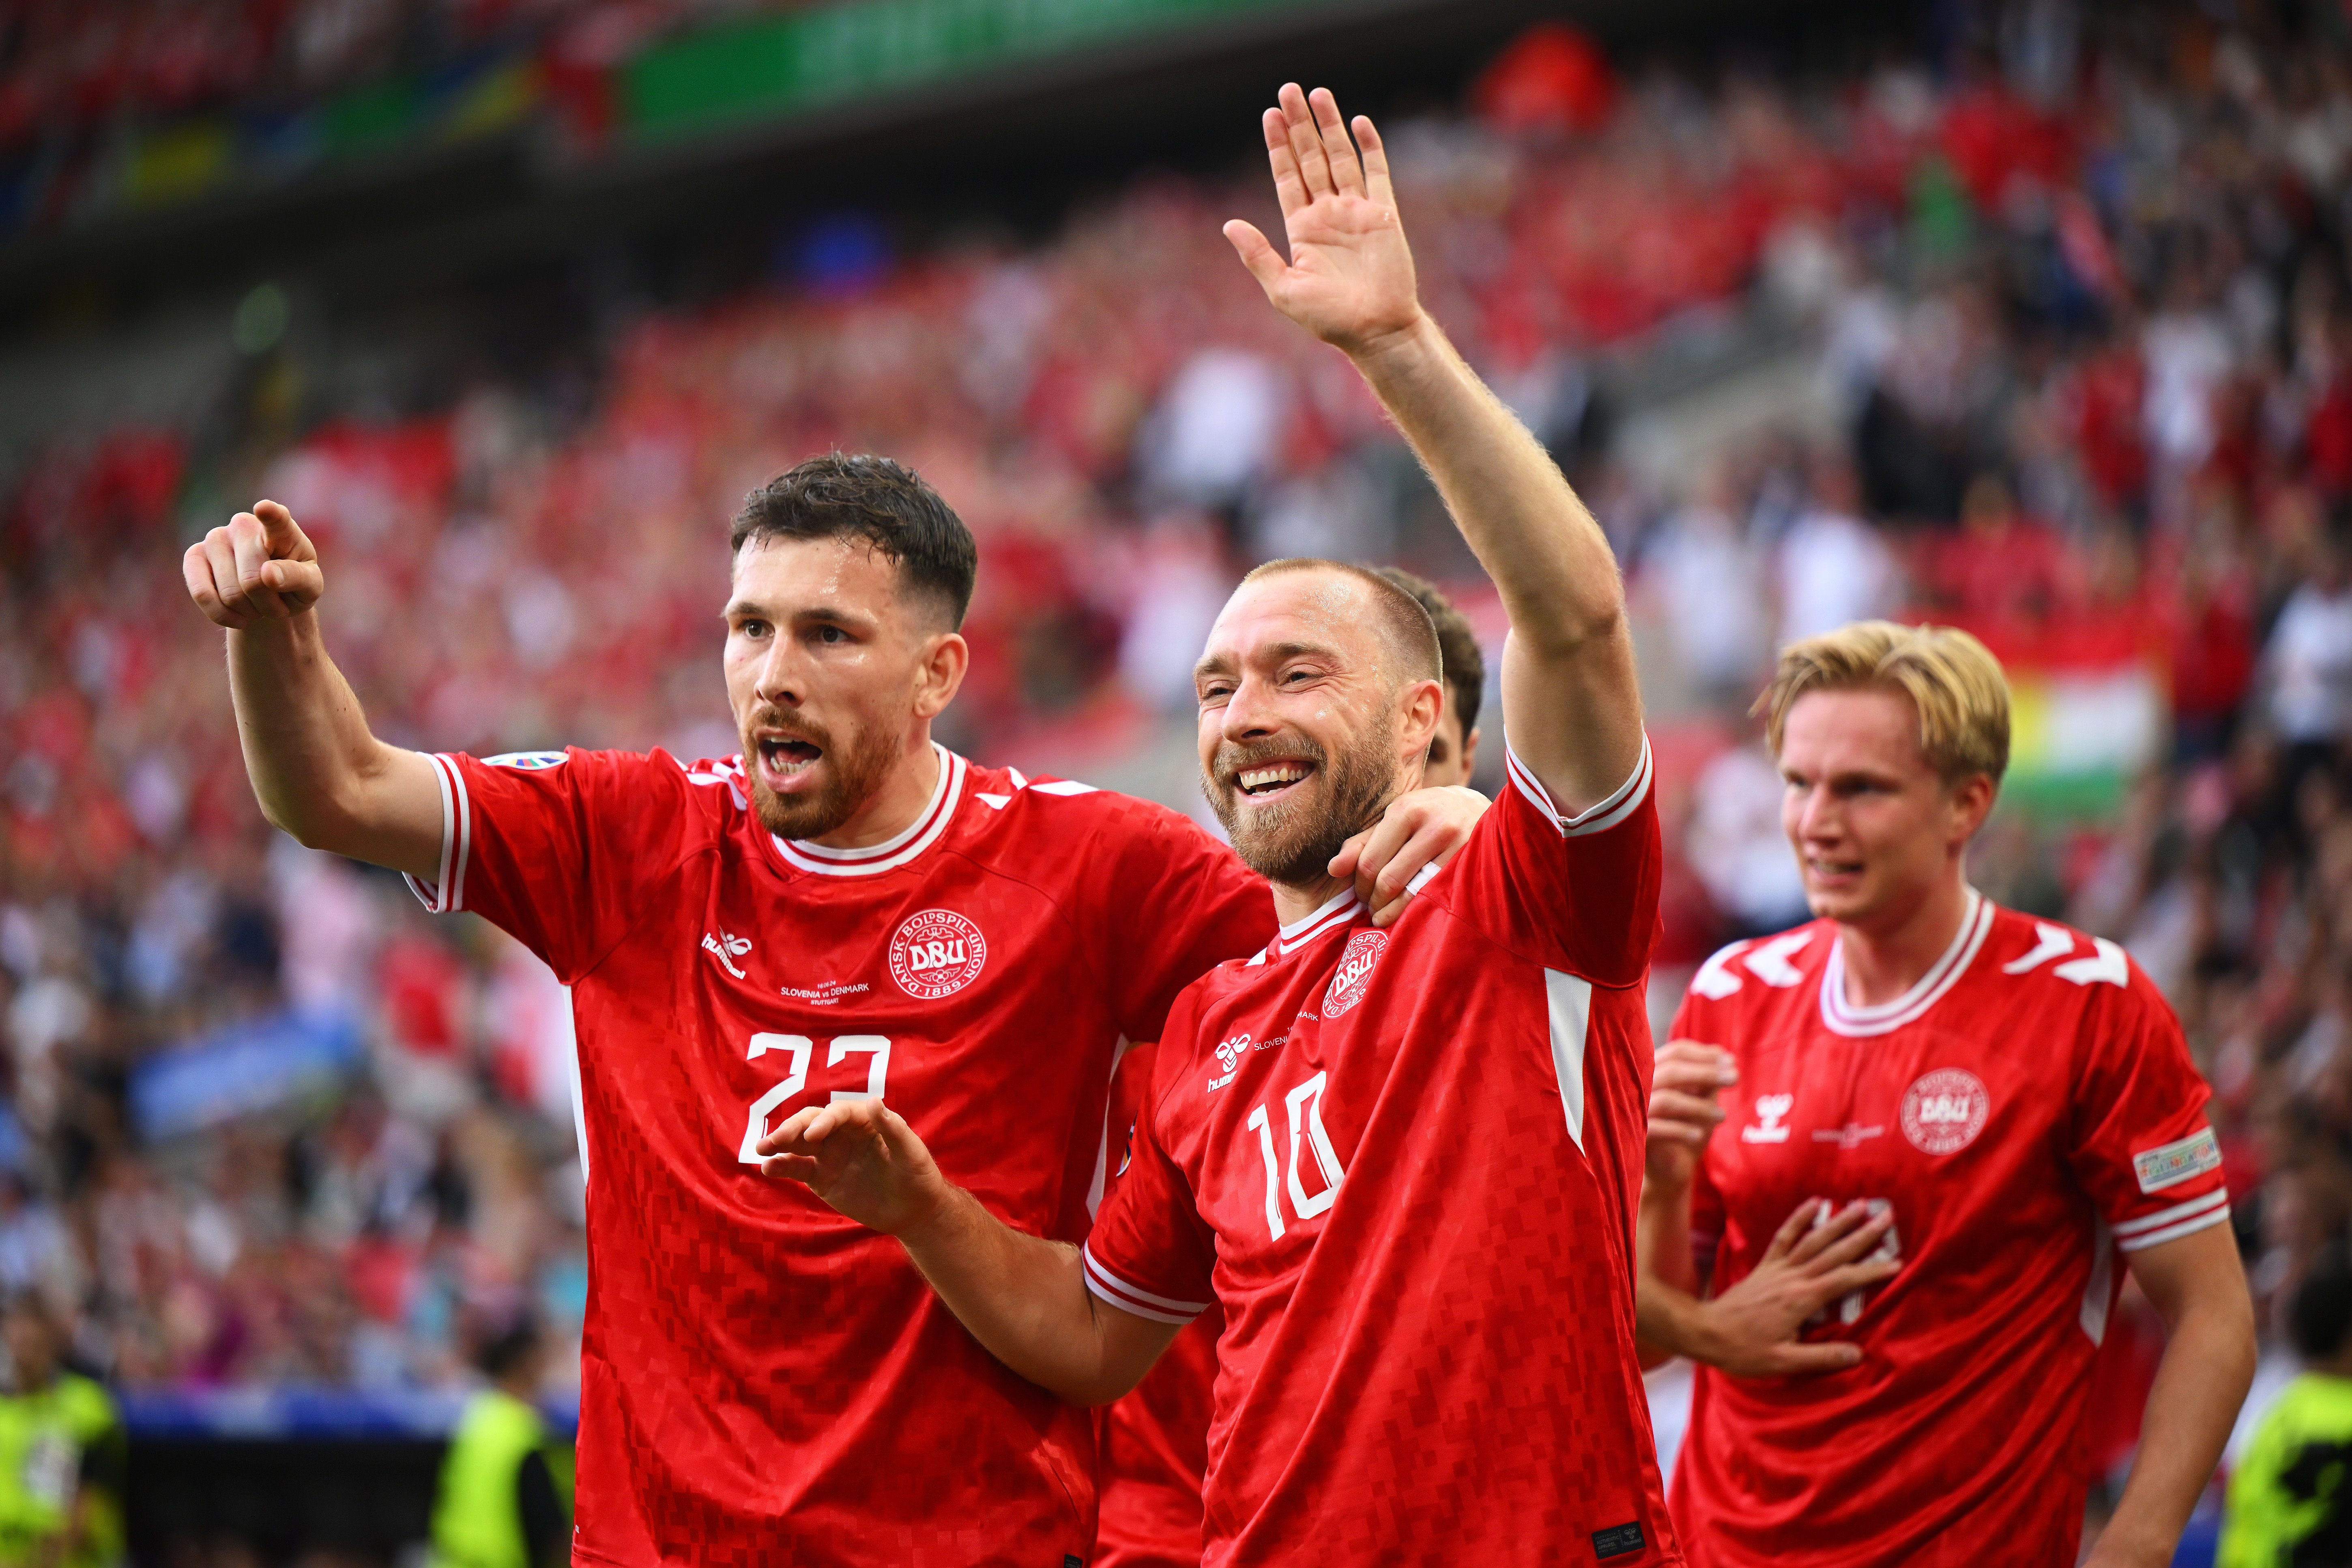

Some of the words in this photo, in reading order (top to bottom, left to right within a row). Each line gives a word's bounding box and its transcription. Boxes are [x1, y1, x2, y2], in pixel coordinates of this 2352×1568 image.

[701, 932, 746, 980] hummel
[893, 940, 919, 993] DANSK
[909, 939, 967, 971] DBU
[1334, 949, 1374, 997] DBU
[781, 987, 821, 998] SLOVENIA
[831, 983, 870, 996] DENMARK
[924, 980, 961, 997] 1889
[1254, 1036, 1287, 1050] SLOVENI
[1296, 1011, 1319, 1021] MARK
[1208, 1070, 1237, 1093] humm
[1247, 1071, 1345, 1242] 10
[1597, 1535, 1620, 1545] AUTHENTIC
[1598, 1542, 1616, 1550] APPAREL
[1623, 1537, 1642, 1546] hummel
